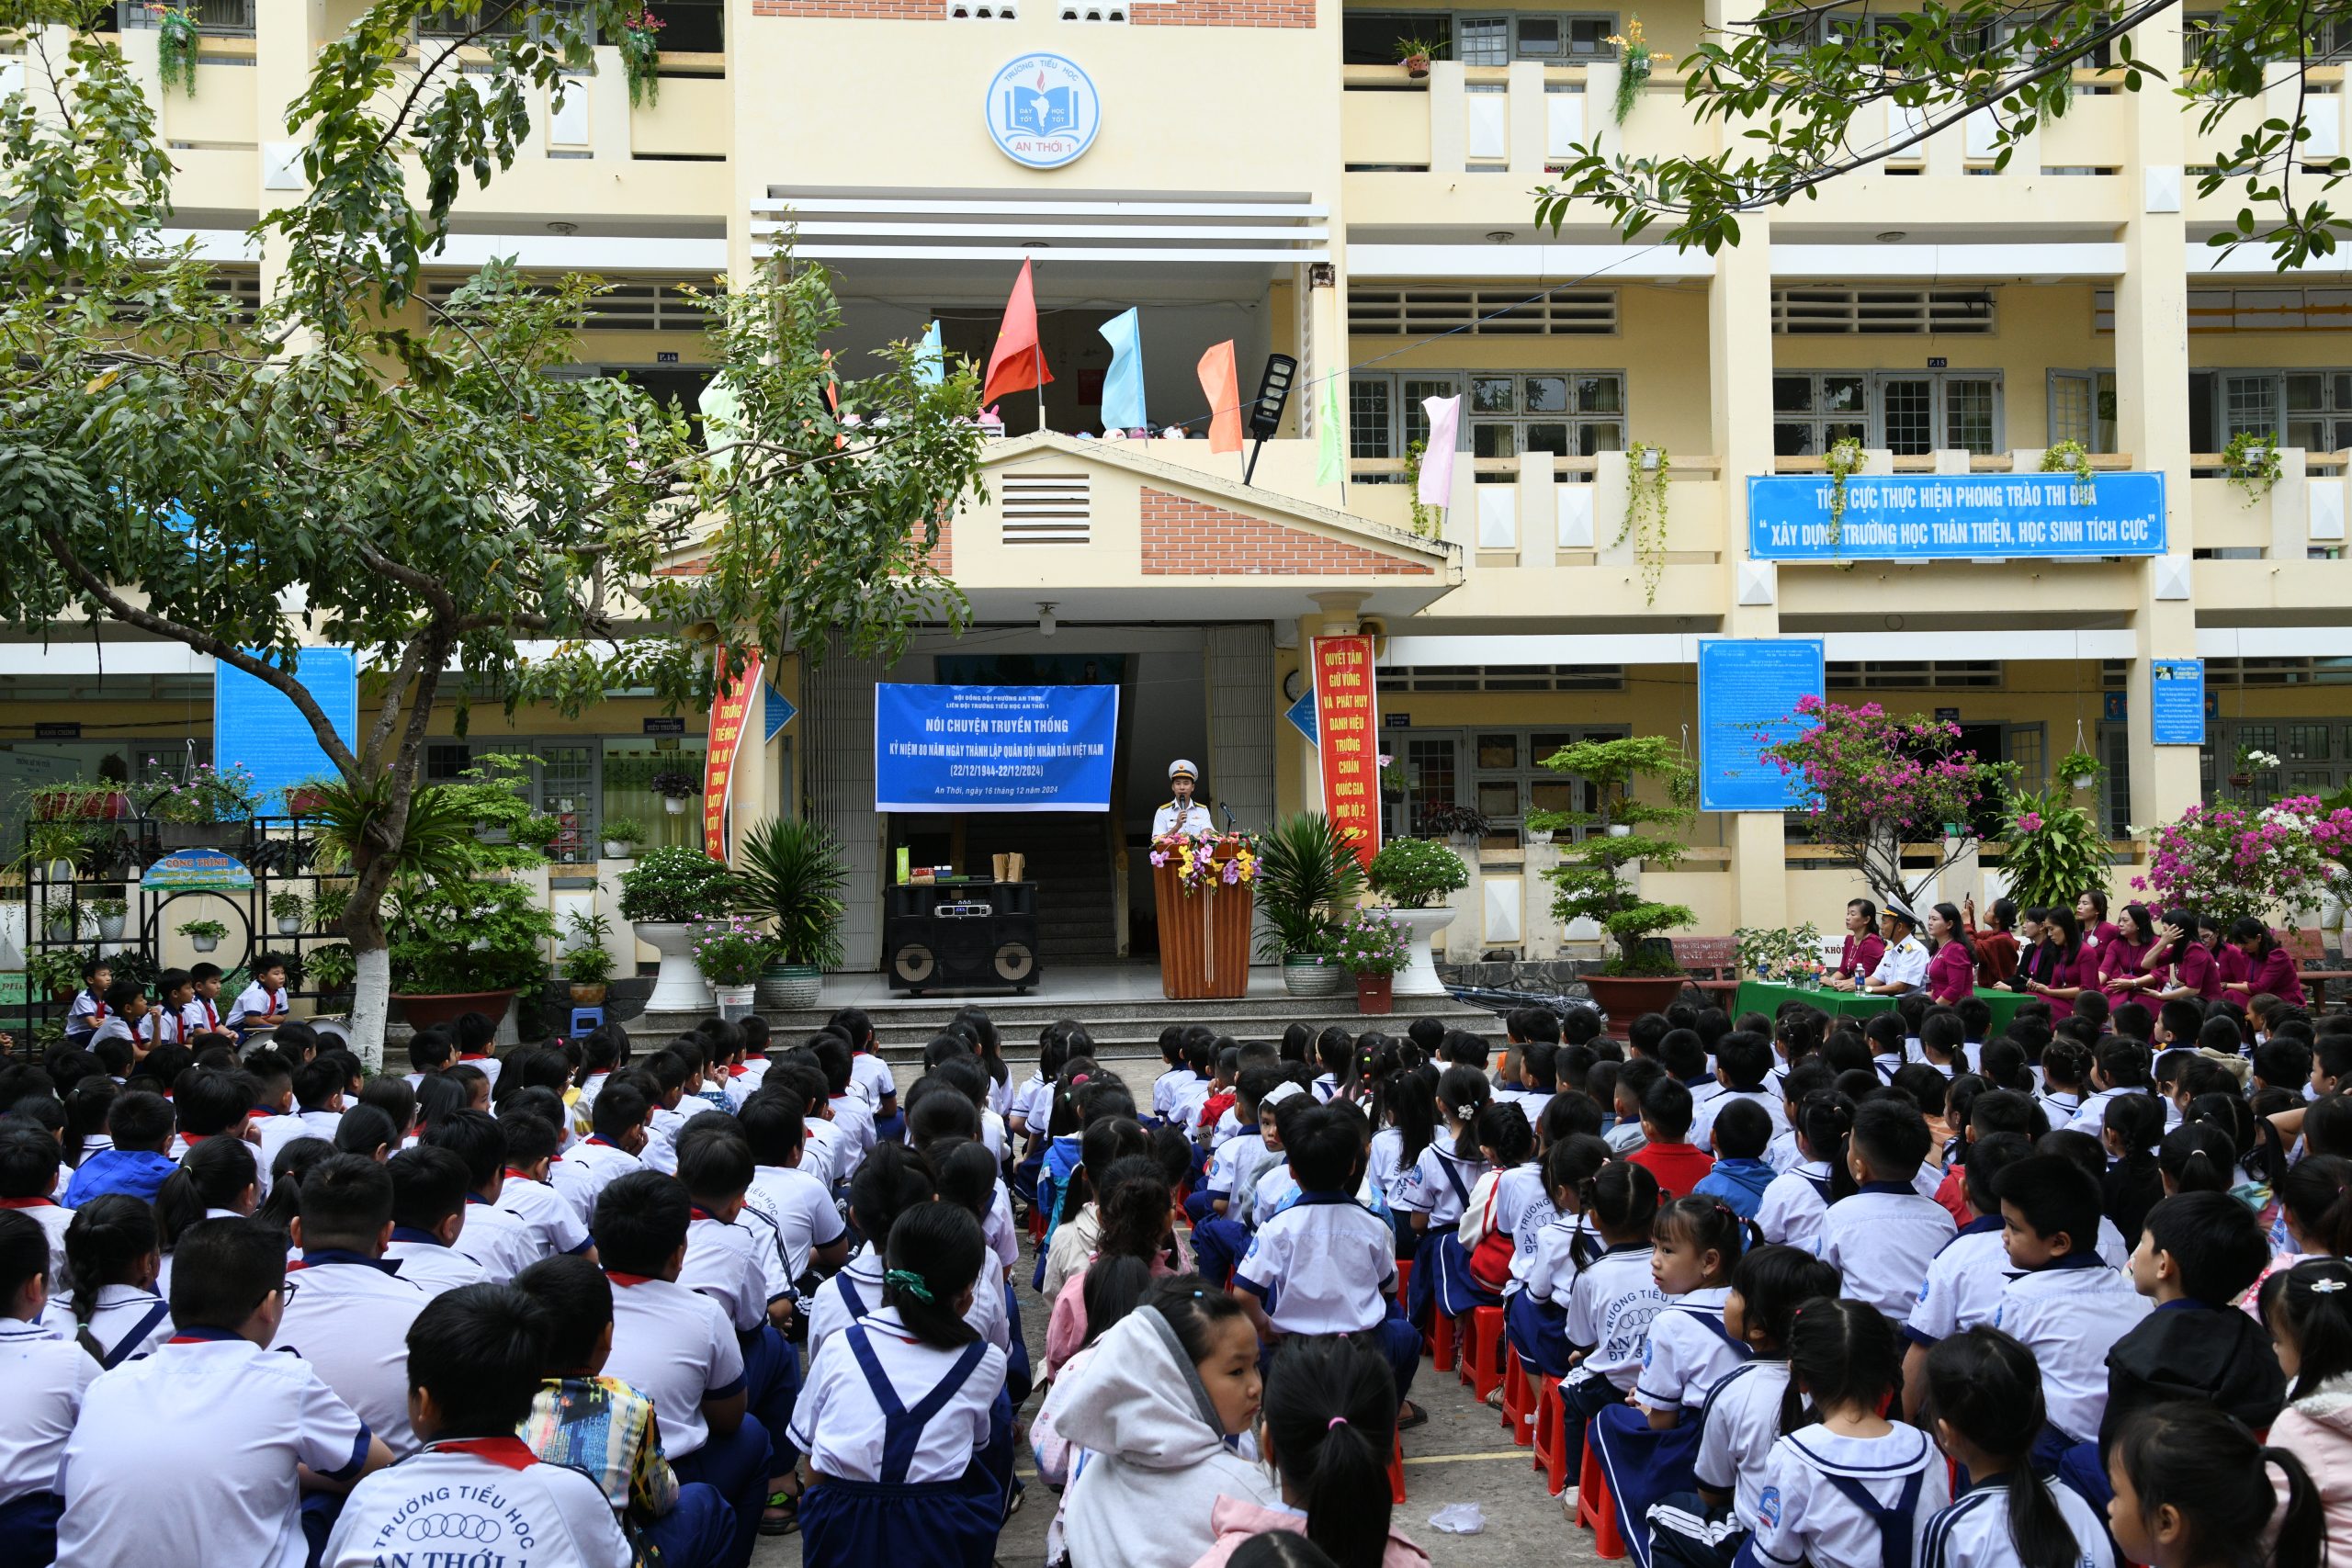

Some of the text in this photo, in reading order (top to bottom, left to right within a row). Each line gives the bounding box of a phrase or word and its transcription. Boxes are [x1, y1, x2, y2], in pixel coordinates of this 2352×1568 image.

[1004, 58, 1080, 83] TRƯỜNG TIỂU HỌC
[1014, 141, 1032, 152] AN
[1067, 143, 1072, 152] 1
[1815, 484, 1848, 510] TÍC
[1850, 486, 1878, 513] CỰC
[1882, 485, 1917, 513] THỰC
[1920, 482, 1952, 513] HIỆN
[1956, 486, 2003, 508] PHONG
[2007, 481, 2041, 506] TRÀO
[2044, 485, 2066, 506] THI
[1843, 519, 1896, 545] TRƯỜNG
[1901, 525, 1928, 549] HỌC
[1932, 518, 1968, 545] THÂN
[1971, 517, 2015, 547] THIỆN,
[2018, 522, 2046, 547] HỌC
[2050, 521, 2083, 542] SINH
[2086, 516, 2117, 542] TÍCH
[1325, 648, 1363, 667] QUYẾT TÂM
[1329, 671, 1360, 687] GIỮ VỮNG
[1324, 693, 1368, 709] VÀ PHÁT HUY
[926, 716, 944, 732] NÓI
[947, 716, 989, 735] CHUYỆN
[1034, 715, 1069, 733] THỐNG
[1329, 714, 1364, 733] DANH HIỆU
[889, 739, 1103, 760] KỶ NIỆM 80 NĂM NGÀY THÀNH LẬP QUÂN ĐỘI NHÂN DÂN VIỆT NAM
[950, 764, 1044, 778] (22/12/1944-22/12/2024)
[965, 787, 983, 796] ngày
[994, 786, 1014, 796] tháng
[1041, 785, 1058, 794] 2024
[1352, 782, 1364, 795] GIA
[1360, 804, 1365, 818] 2
[165, 855, 229, 868] CÔNG TRÌNH
[1825, 944, 1843, 953] KHÔ
[1521, 1198, 1551, 1231] TRƯỜNG
[1606, 1288, 1668, 1336] TRƯỜNG TIỂU
[1607, 1336, 1630, 1350] AN
[373, 1483, 535, 1551] TRƯỜNG TIỂU HỌC
[373, 1551, 414, 1568] AN
[517, 1551, 526, 1568] 1
